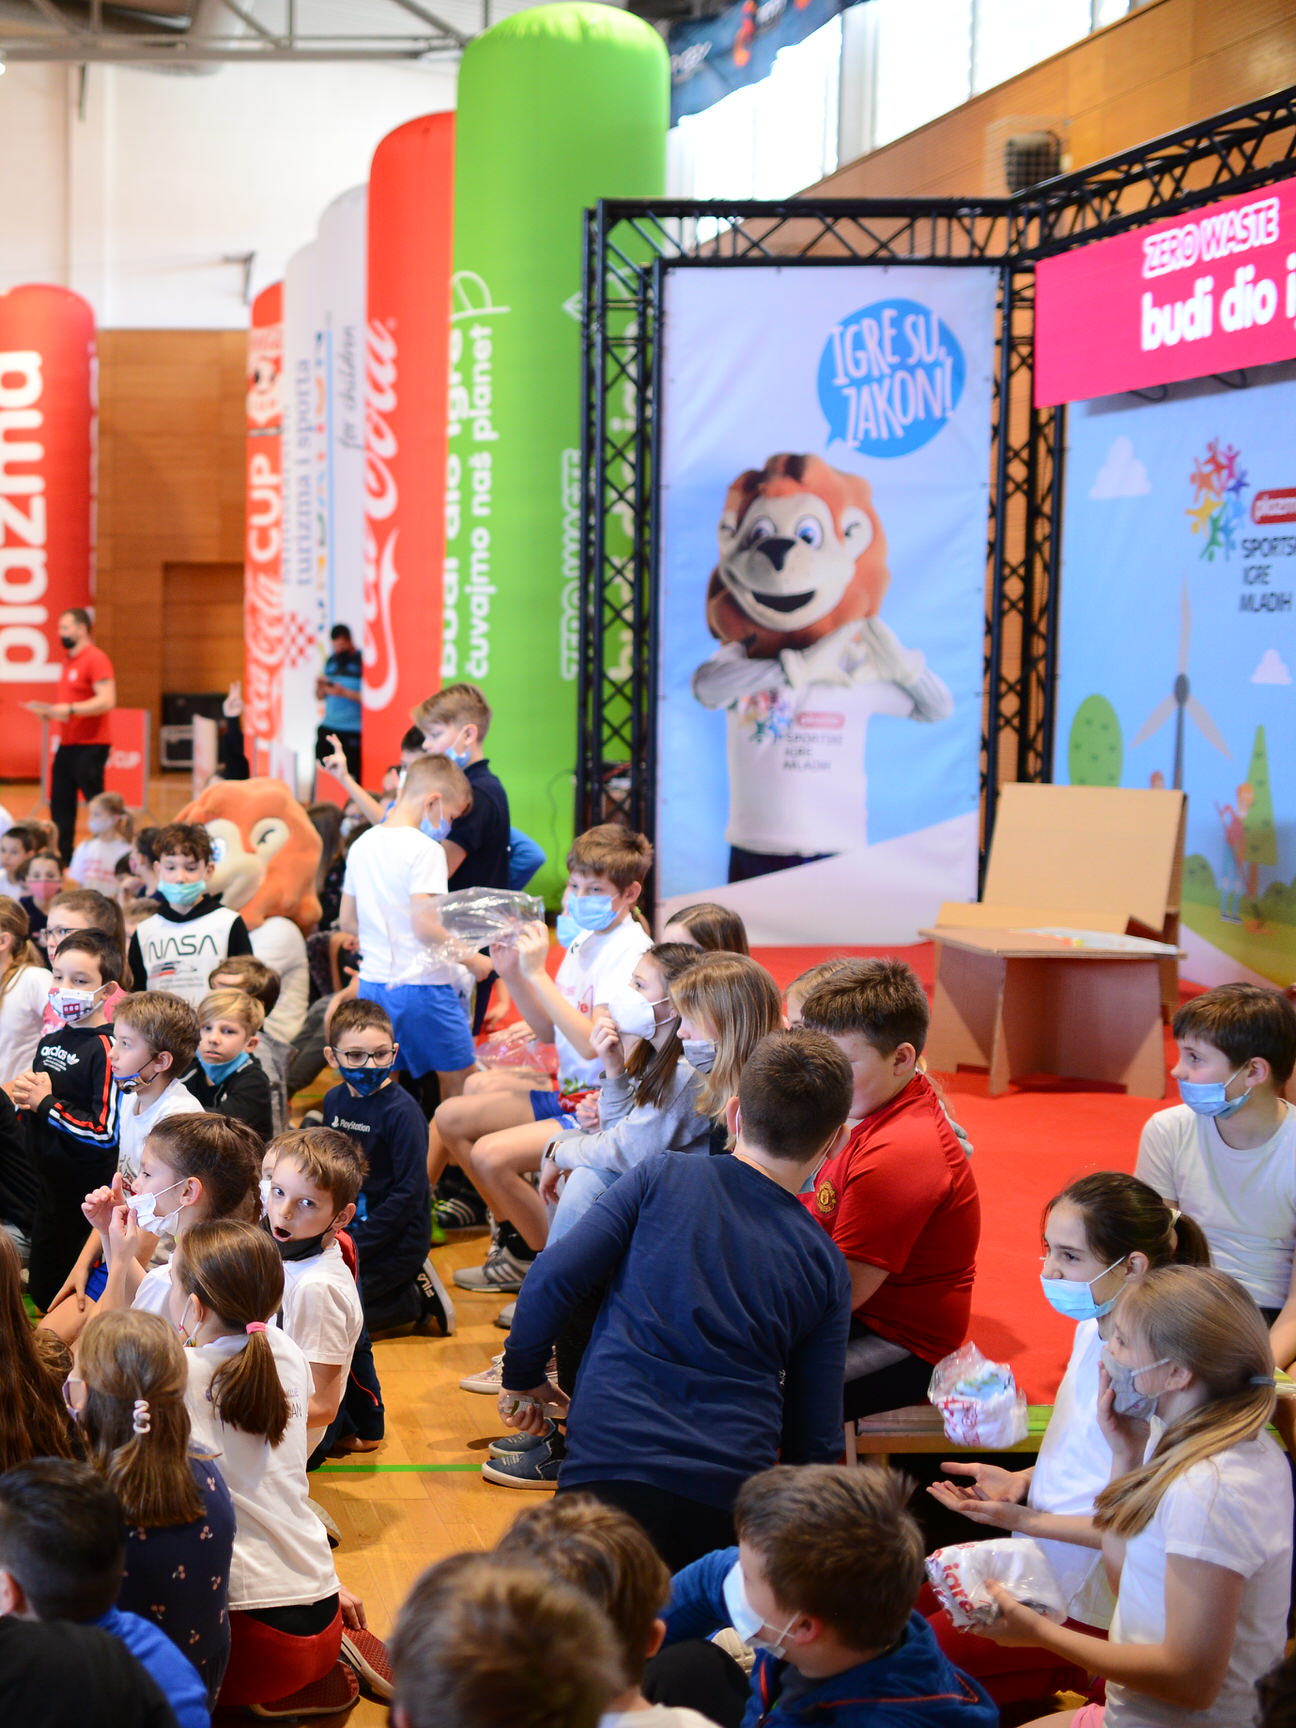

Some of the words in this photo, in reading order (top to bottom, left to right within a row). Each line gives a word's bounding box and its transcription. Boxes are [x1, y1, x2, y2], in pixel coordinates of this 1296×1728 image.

[1143, 223, 1200, 279] ZERO
[1200, 197, 1280, 262] WASTE
[832, 308, 901, 386] IGRE
[1141, 275, 1214, 352] budi
[1220, 264, 1278, 333] dio
[469, 324, 499, 441] planet
[841, 357, 954, 448] ZAKON!
[249, 453, 282, 562] CUP
[468, 450, 492, 516] naš
[1242, 536, 1296, 558] SPORTS
[1243, 565, 1272, 585] IGRE
[464, 527, 497, 679] čuvajmo
[1239, 592, 1292, 612] MLADIH
[148, 934, 219, 963] NASA
[339, 1118, 371, 1133] PlayStation
